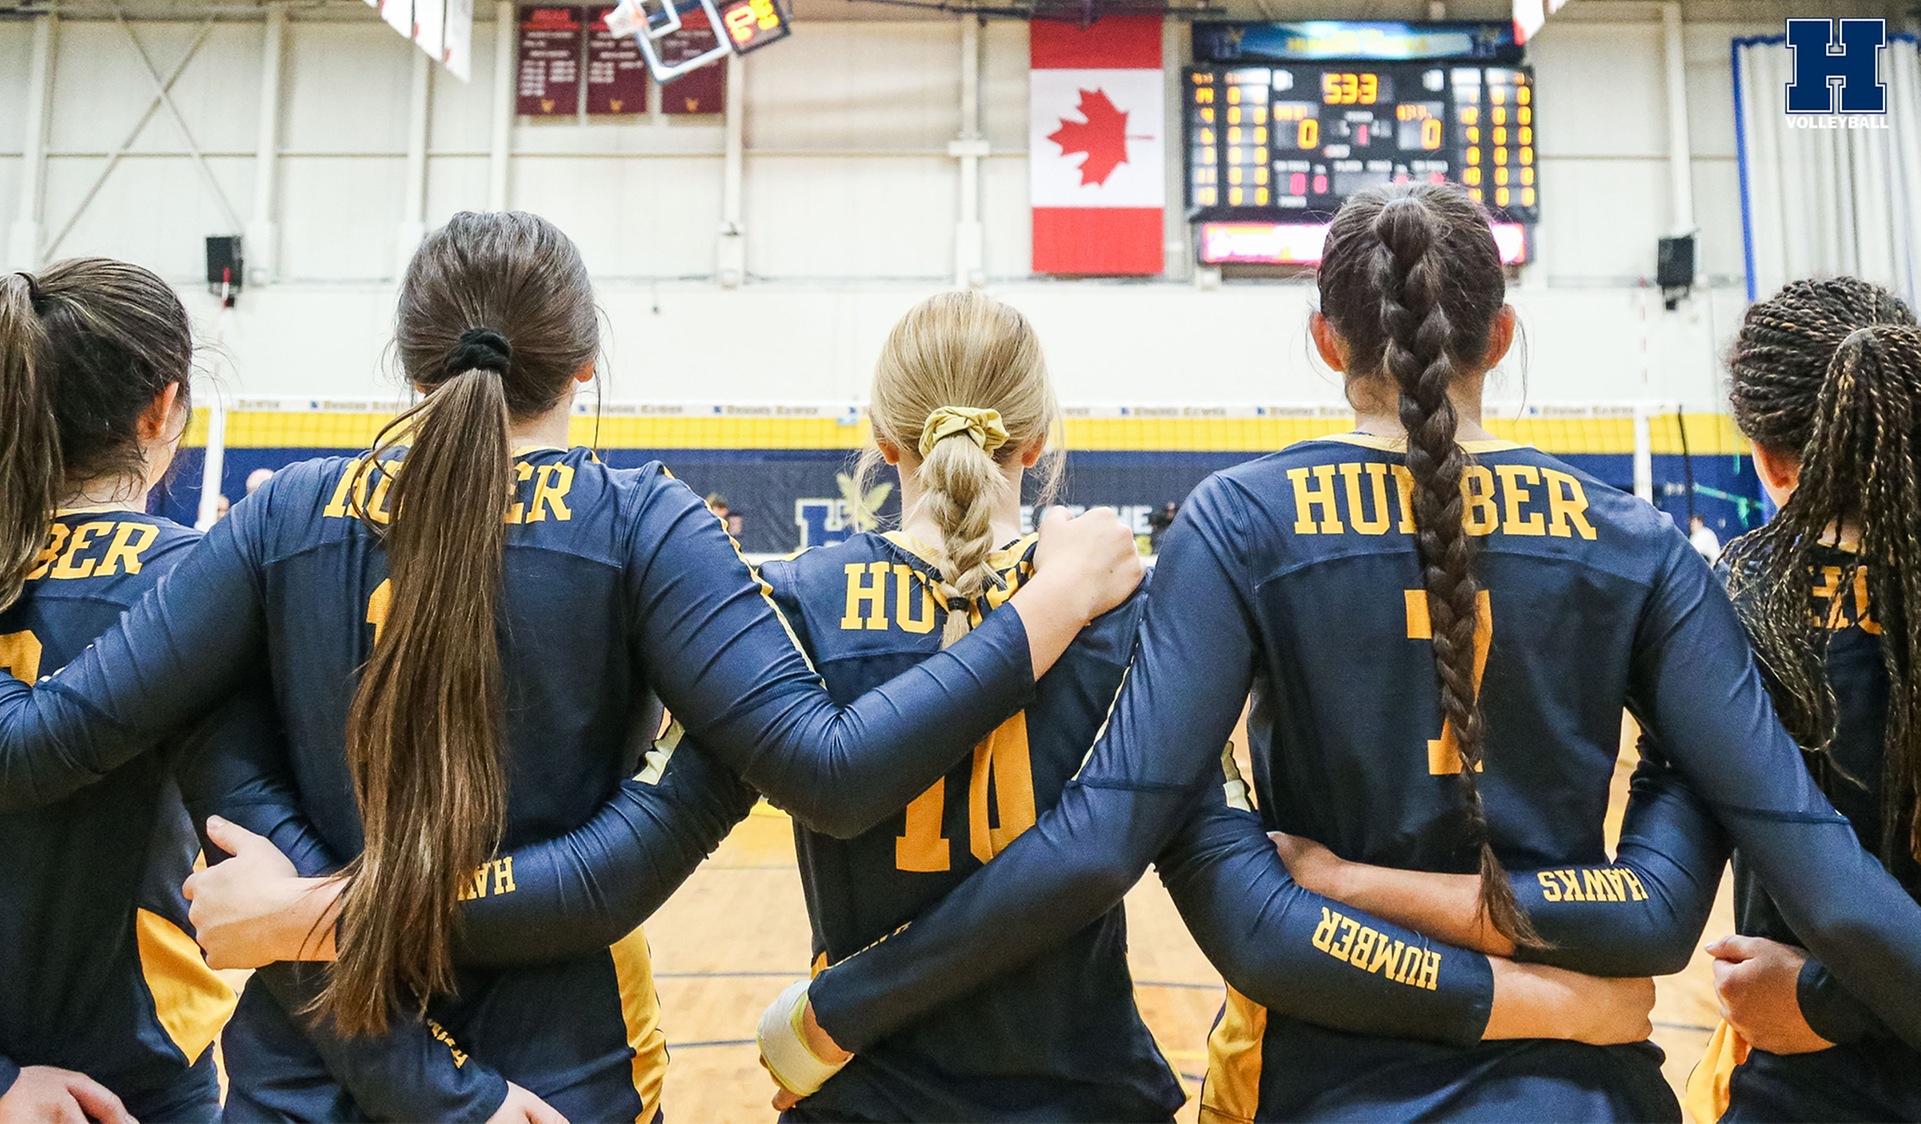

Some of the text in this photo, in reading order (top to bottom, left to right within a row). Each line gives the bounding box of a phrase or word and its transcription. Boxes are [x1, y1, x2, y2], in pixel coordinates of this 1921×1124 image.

[1297, 119, 1319, 149] 0
[1421, 119, 1442, 149] 0
[1286, 462, 1598, 540] HUBER
[26, 521, 160, 580] BER
[1537, 868, 1649, 902] HAWKS
[1311, 906, 1442, 991] HUMBER
